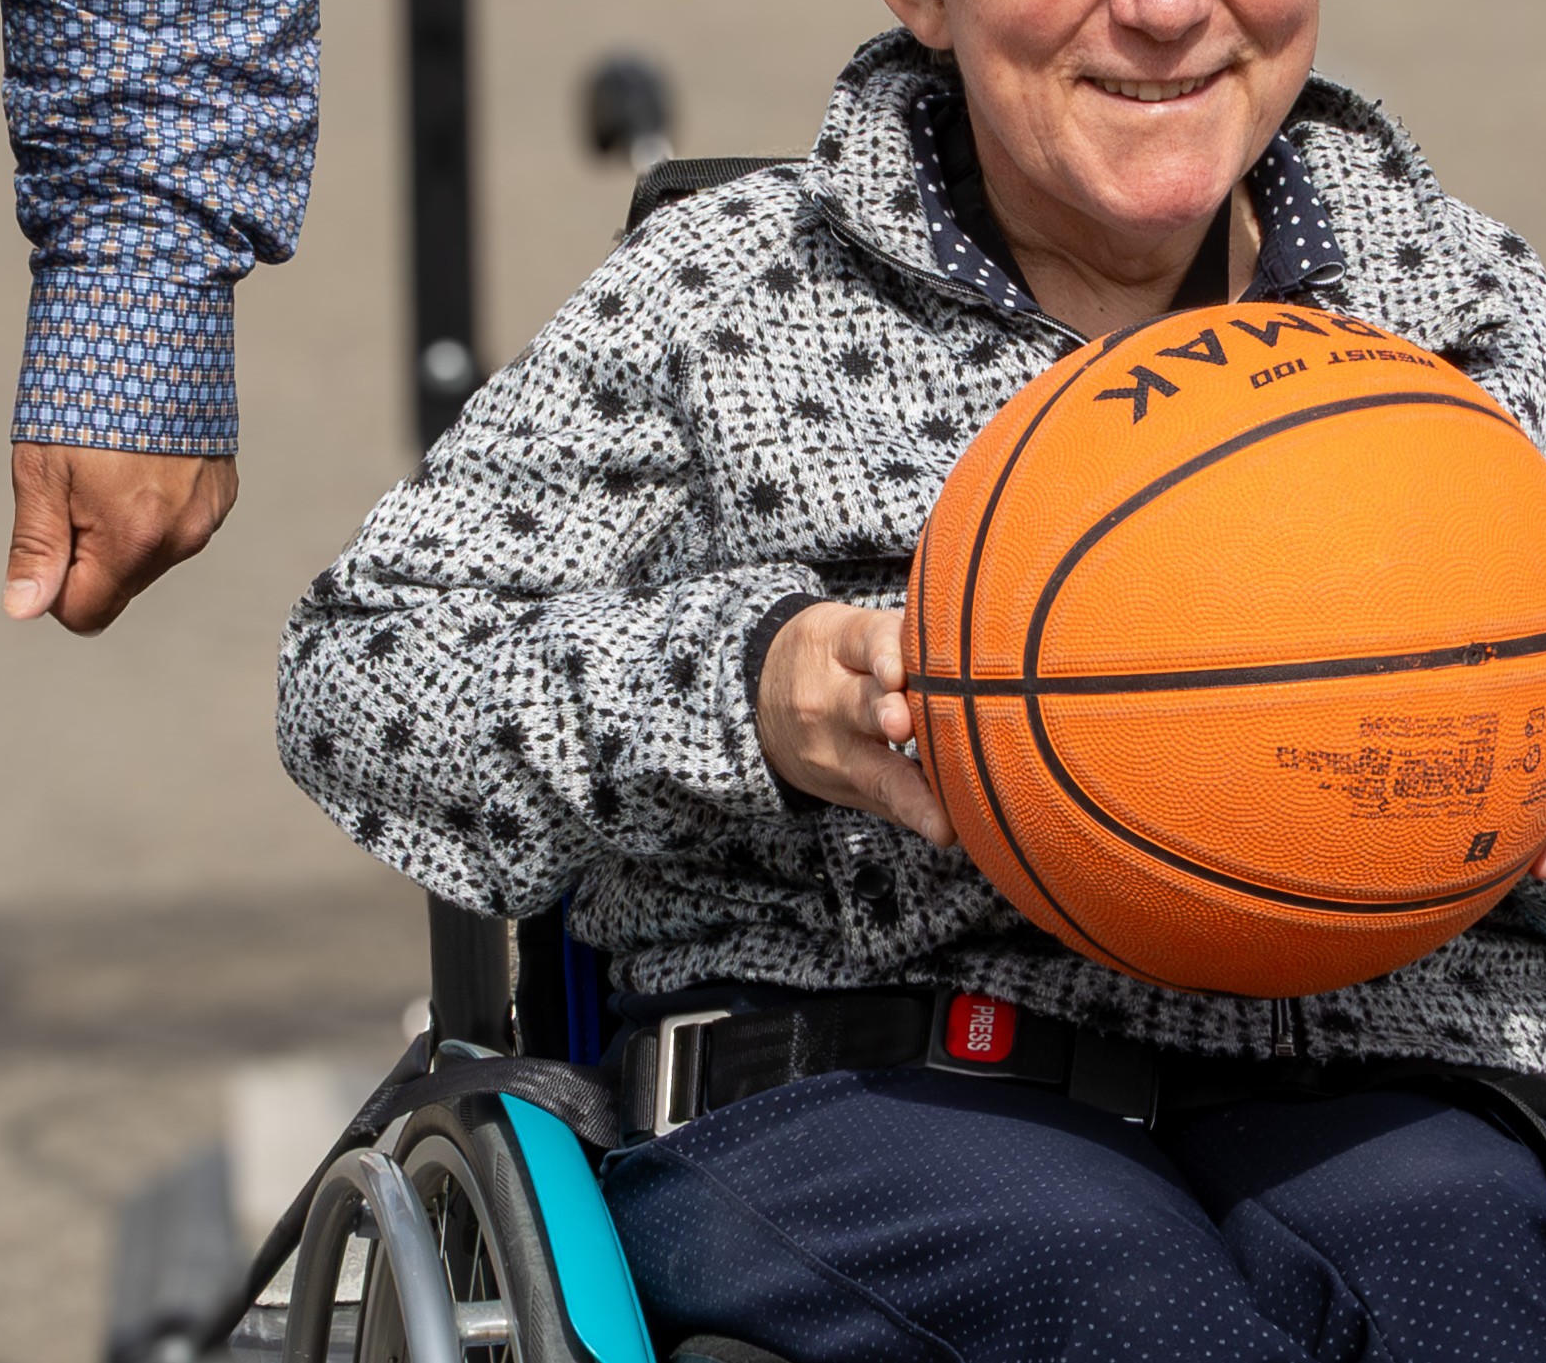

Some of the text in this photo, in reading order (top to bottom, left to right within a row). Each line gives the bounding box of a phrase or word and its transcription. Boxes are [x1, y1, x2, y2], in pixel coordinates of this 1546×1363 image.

[1249, 349, 1438, 389] RESIST 100
[967, 1005, 995, 1052] PRESS
